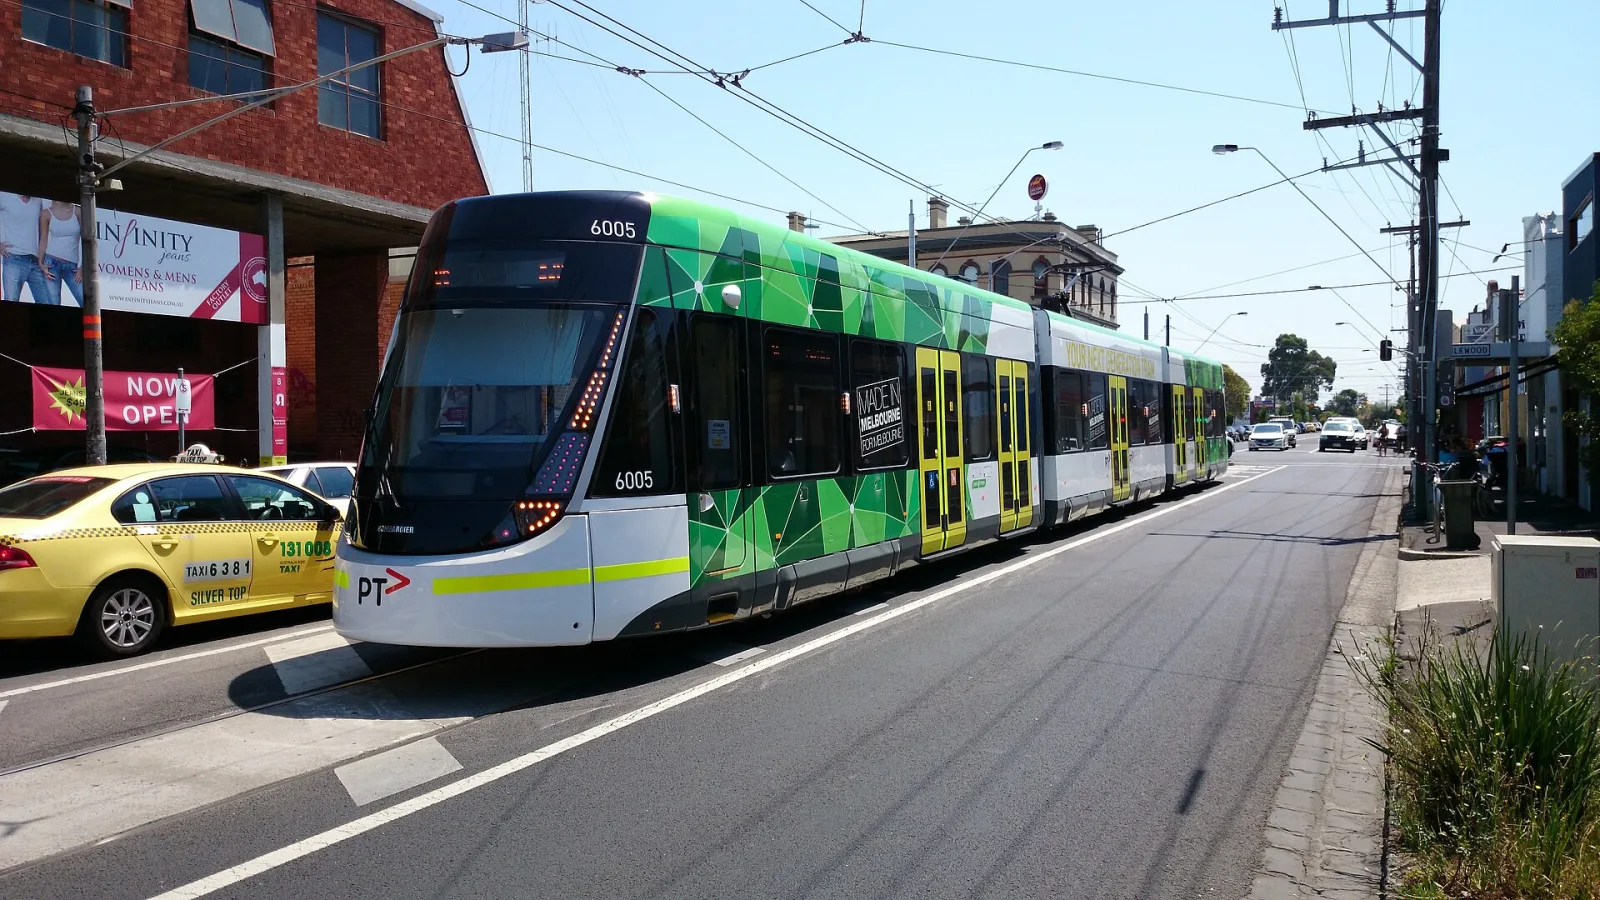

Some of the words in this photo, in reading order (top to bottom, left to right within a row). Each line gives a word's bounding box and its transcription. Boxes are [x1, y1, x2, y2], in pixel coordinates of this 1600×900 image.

[591, 219, 635, 238] 6005
[158, 250, 191, 264] jeans
[153, 270, 161, 280] &
[165, 271, 196, 284] MENS
[130, 279, 164, 292] JEANS
[206, 280, 229, 306] FACTORY
[212, 287, 232, 310] OUTLET
[1454, 347, 1488, 355] LKWOOD
[66, 398, 85, 407] $49
[859, 385, 889, 415] MADE
[890, 383, 900, 406] IN
[861, 407, 901, 432] MELBOURNE
[187, 448, 202, 457] TAXI
[615, 471, 653, 490] 6005
[280, 541, 301, 557] 131
[304, 541, 332, 556] 008
[280, 565, 301, 574] TAXI
[190, 589, 224, 606] SILVER
[228, 586, 247, 601] TOP
